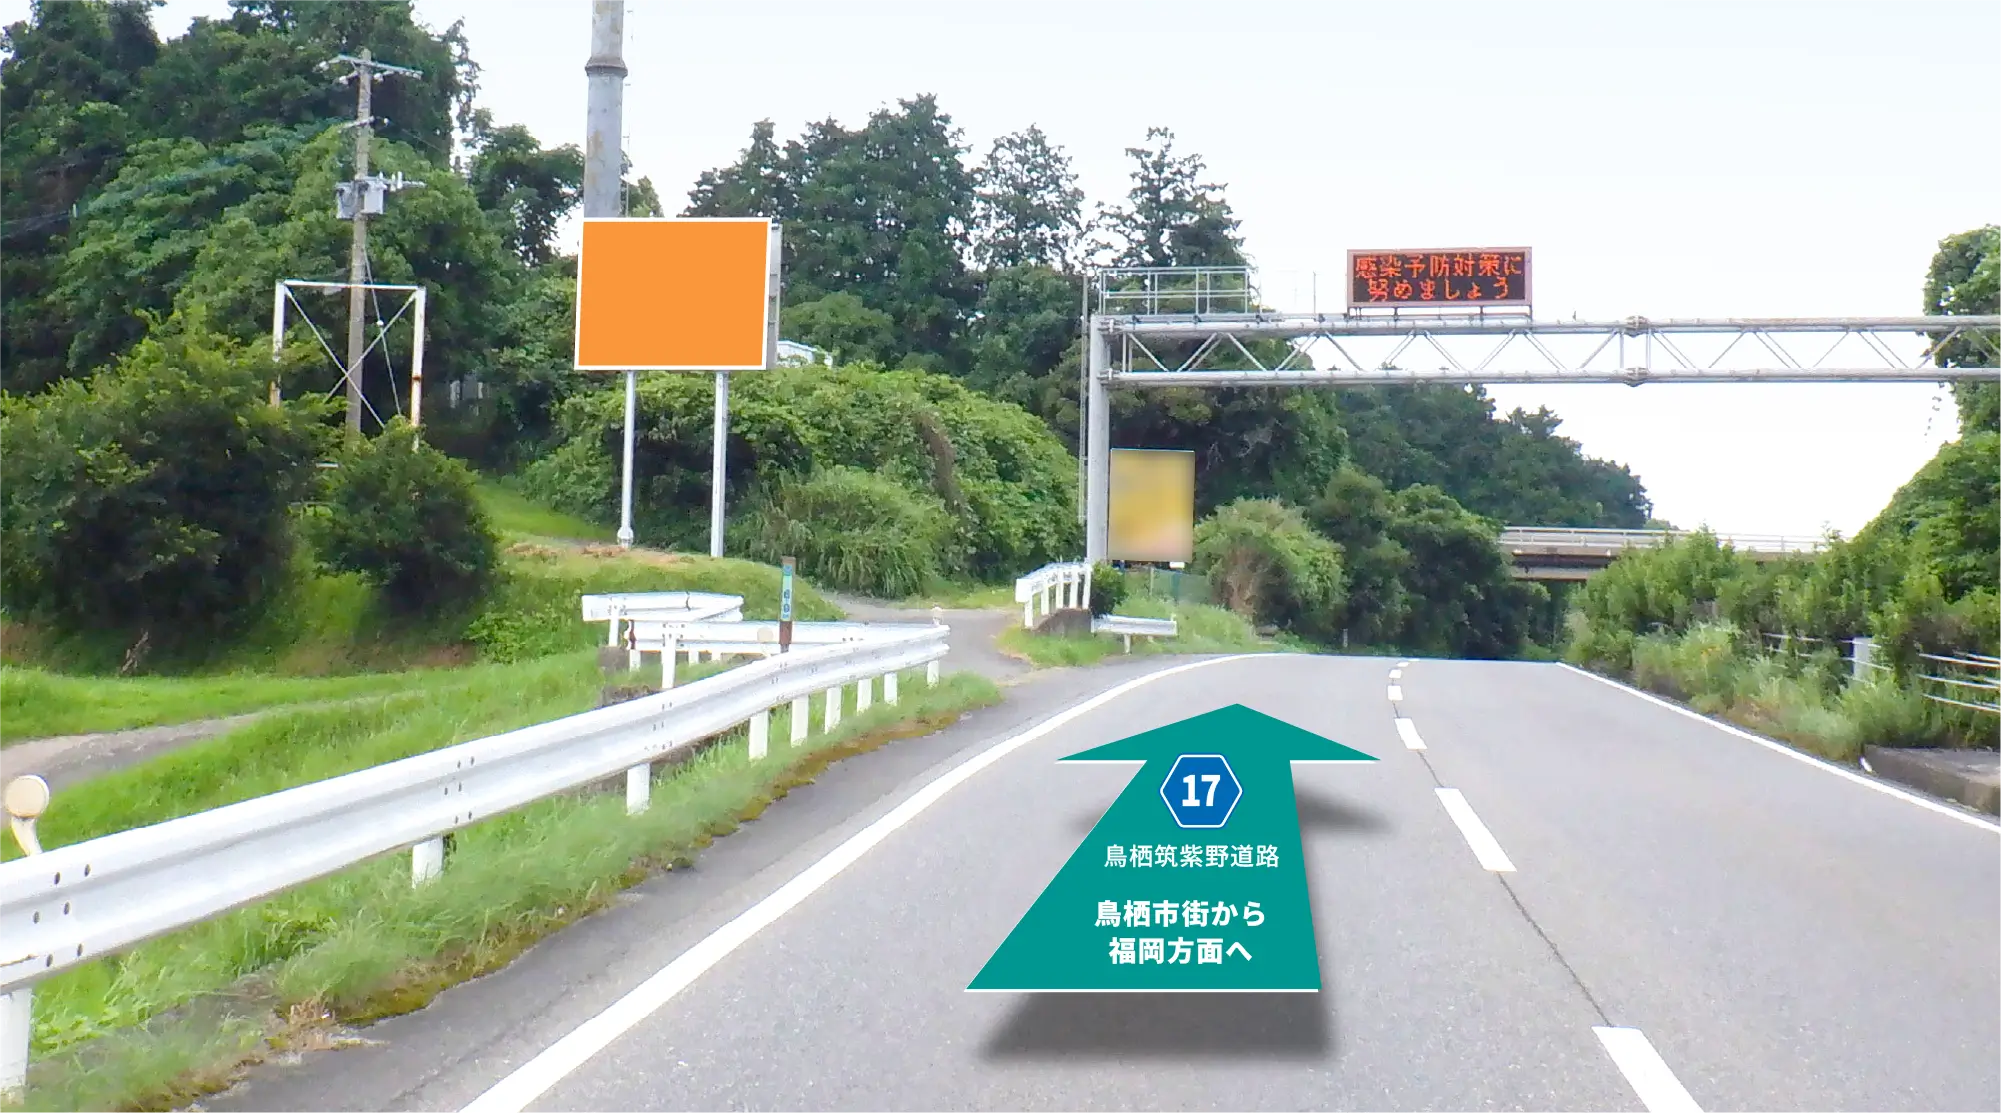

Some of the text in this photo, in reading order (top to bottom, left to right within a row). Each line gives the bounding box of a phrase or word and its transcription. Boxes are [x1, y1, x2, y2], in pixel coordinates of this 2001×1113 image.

[1355, 253, 1522, 278] 感染予防対策に
[1368, 277, 1508, 302] 努めましょう
